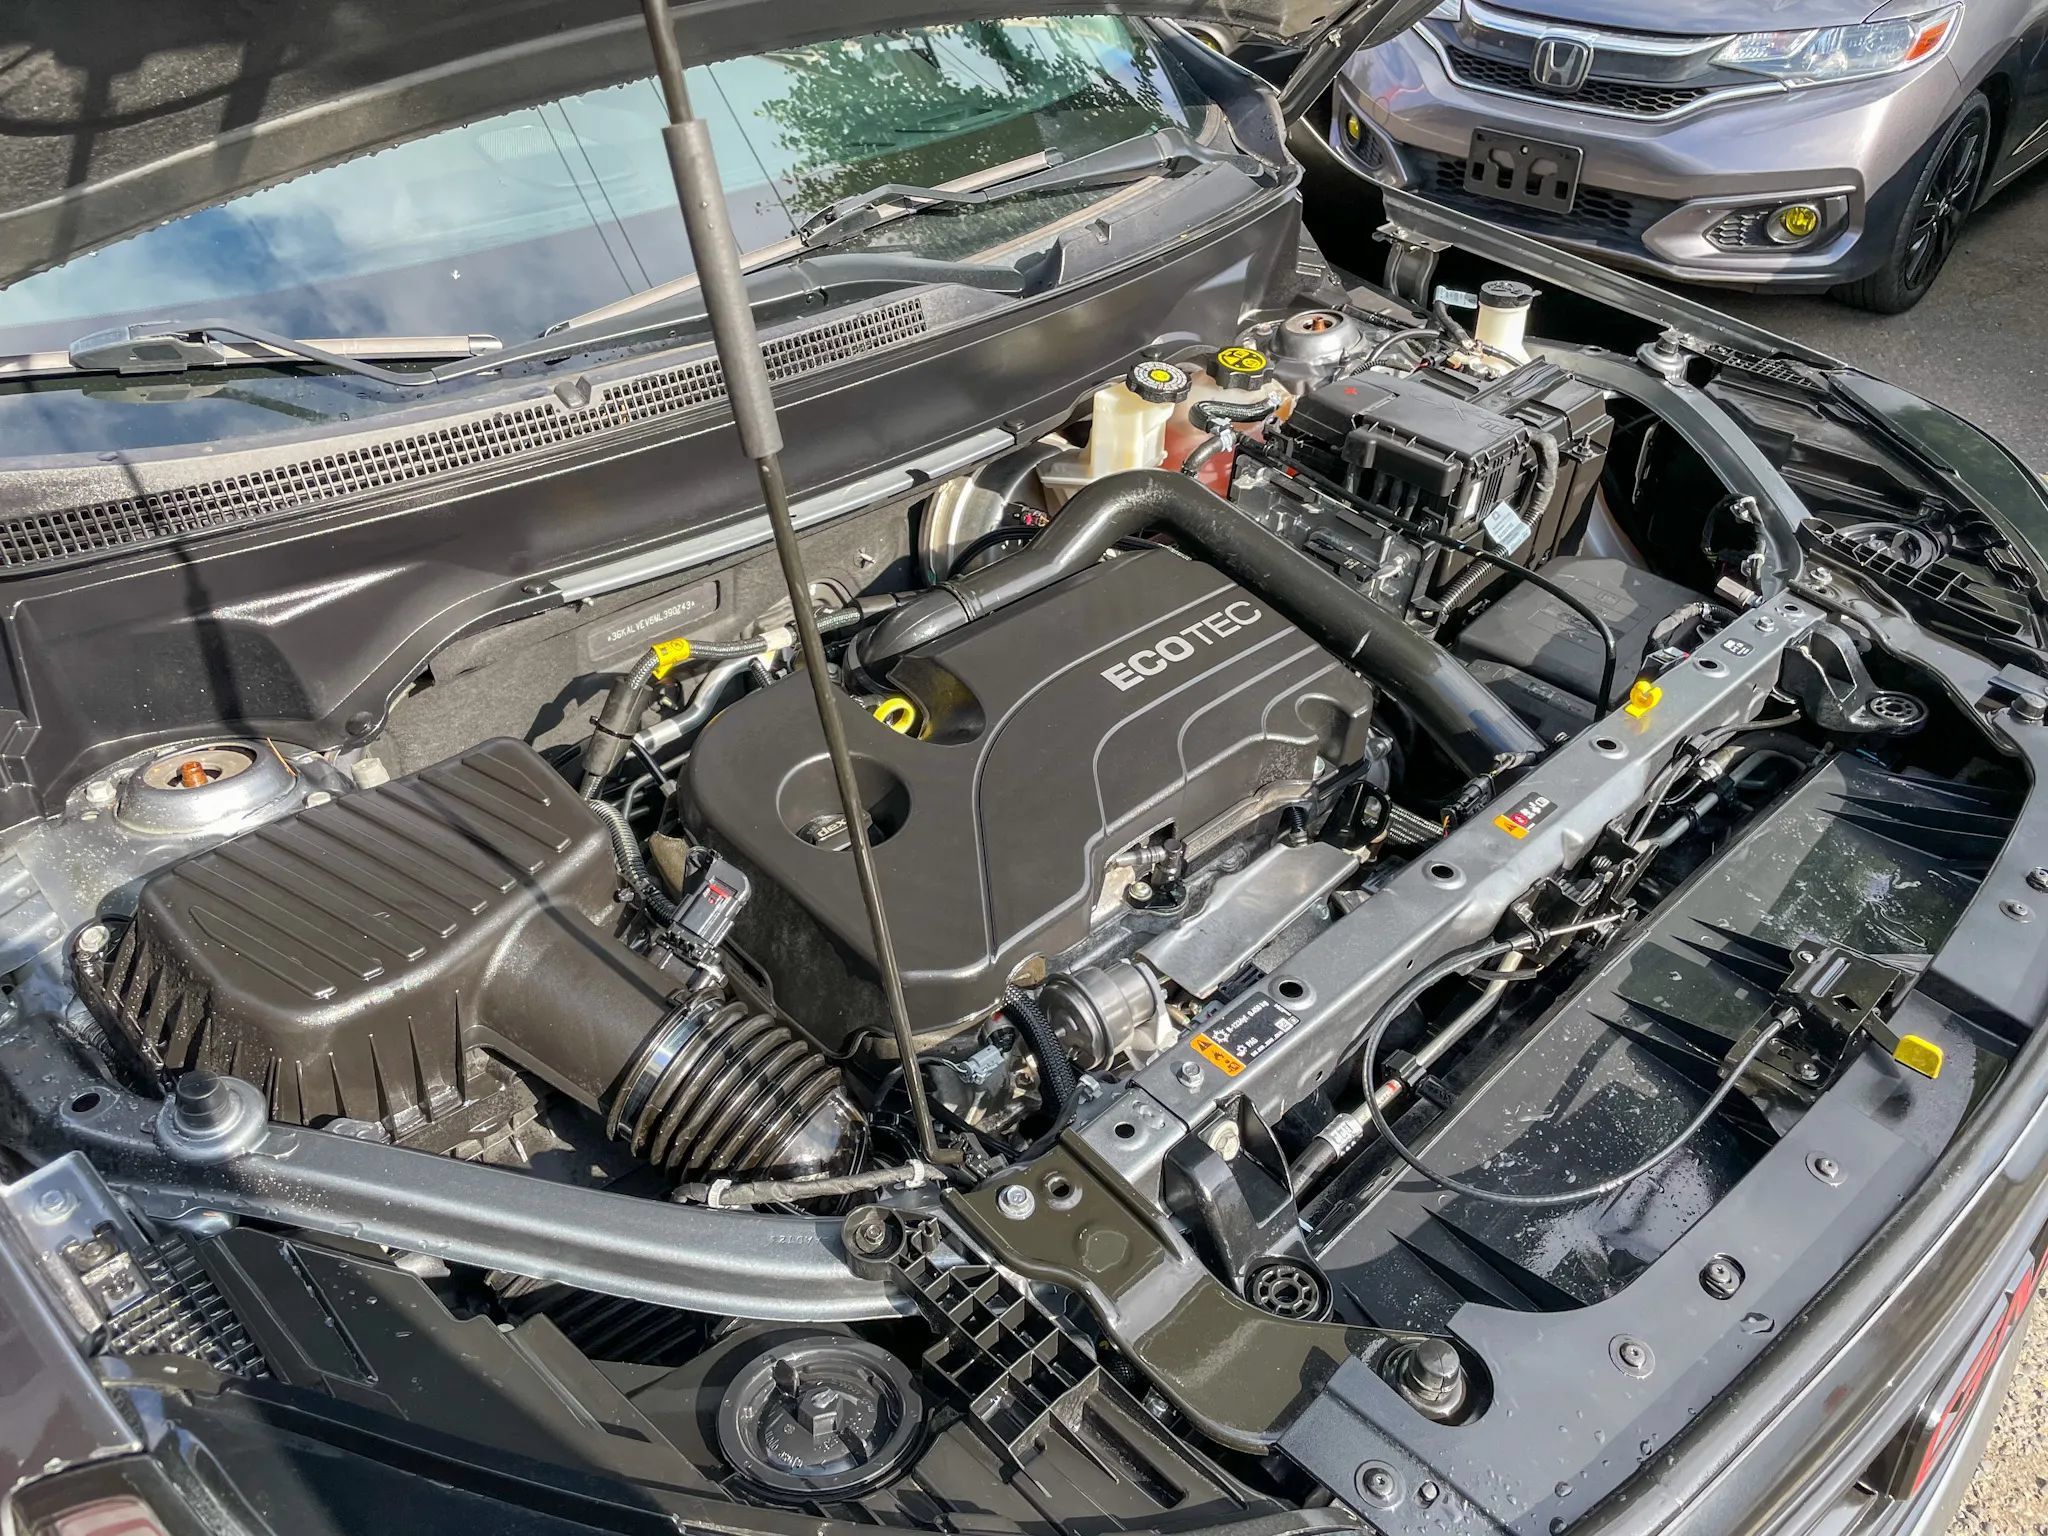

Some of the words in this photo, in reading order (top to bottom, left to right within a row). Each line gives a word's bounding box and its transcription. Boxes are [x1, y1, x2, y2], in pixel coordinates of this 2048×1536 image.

[1100, 601, 1262, 691] ECOTEC
[817, 819, 847, 837] dex
[1244, 1036, 1259, 1048] PAG
